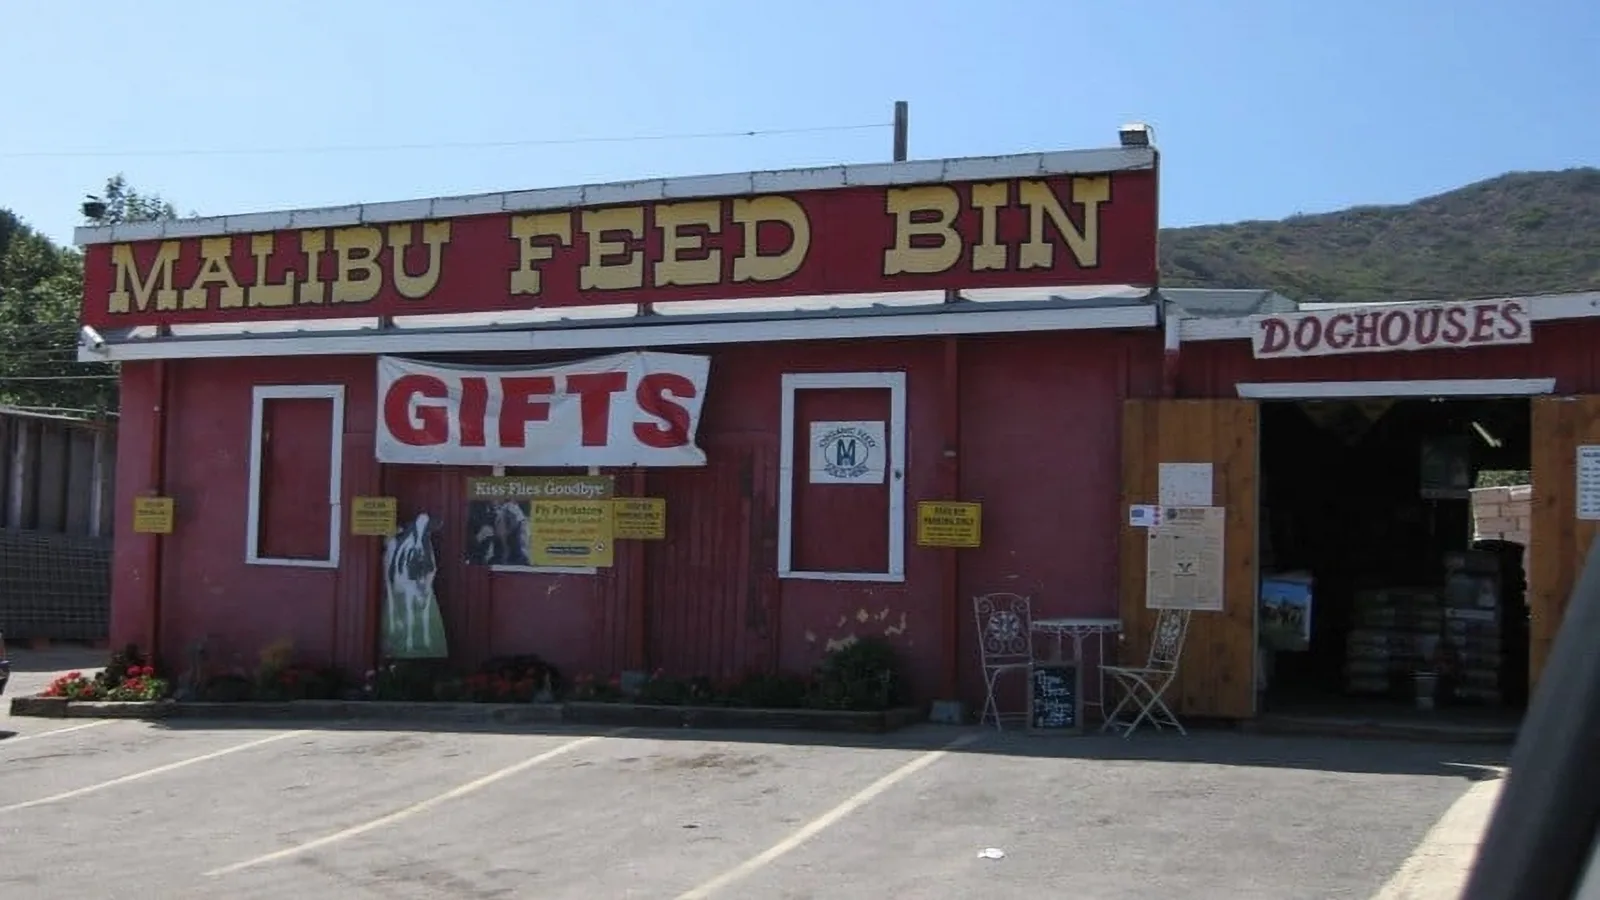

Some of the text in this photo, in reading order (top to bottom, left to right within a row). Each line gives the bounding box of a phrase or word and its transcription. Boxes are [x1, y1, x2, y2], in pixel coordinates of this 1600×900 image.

[108, 176, 1112, 315] MALIBU FEED BIN
[1259, 302, 1524, 353] DOGHOUSES
[383, 370, 698, 449] GIFTS
[475, 481, 605, 499] Kiss Flies Goodbye
